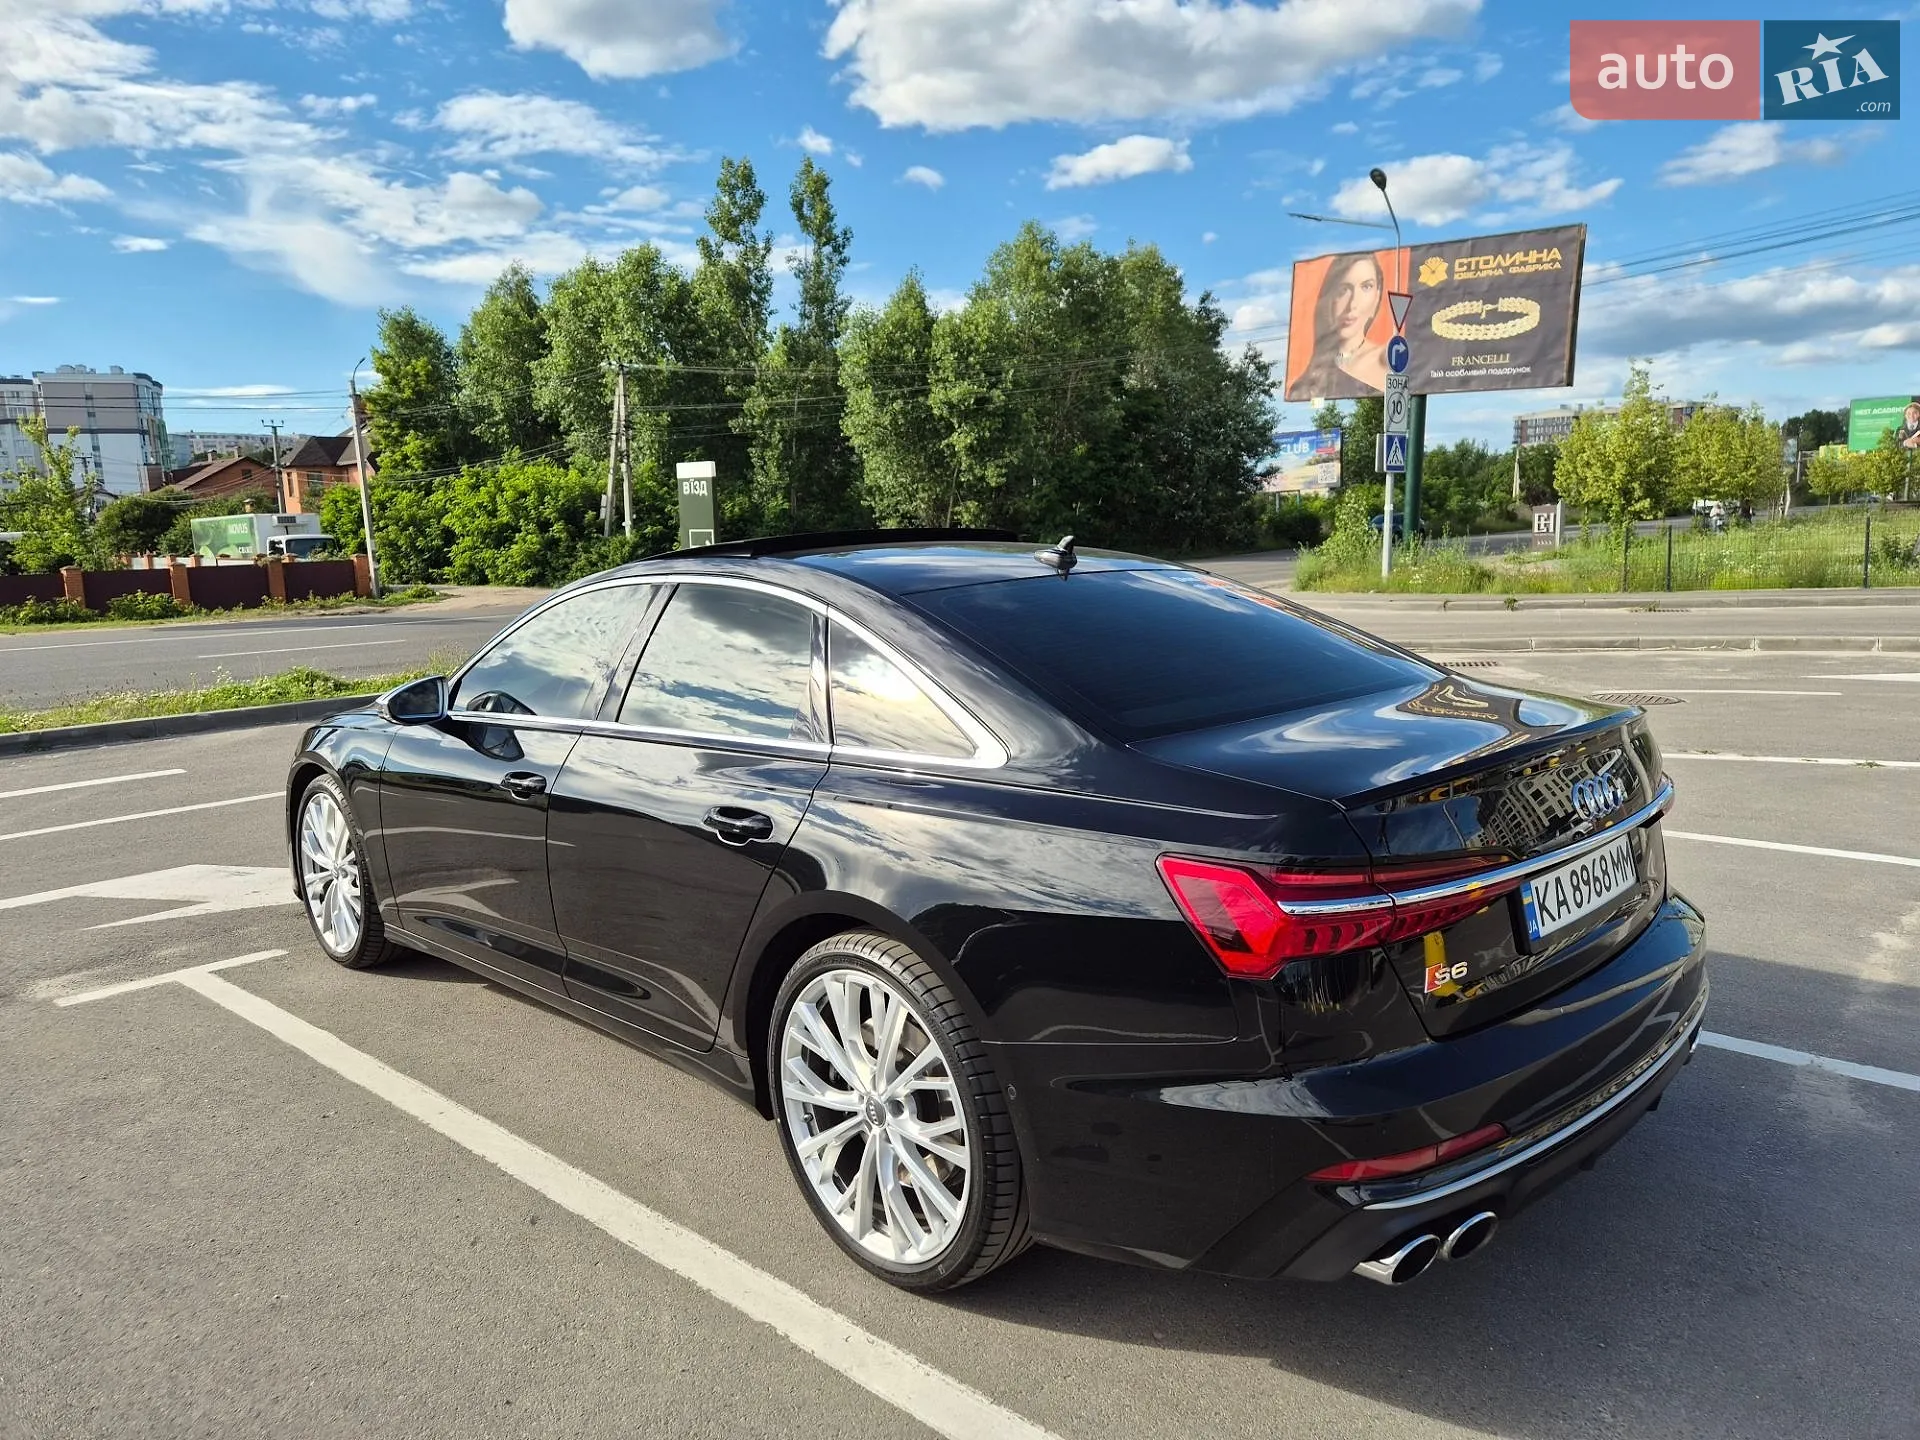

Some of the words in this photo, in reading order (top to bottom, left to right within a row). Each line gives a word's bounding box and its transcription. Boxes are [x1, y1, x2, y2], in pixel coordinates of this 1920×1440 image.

[1454, 247, 1562, 273] СТОЛИЧНА
[1451, 353, 1510, 366] FRANCELLI
[1445, 367, 1487, 377] особливий
[1387, 377, 1409, 390] ЗОНА
[1392, 400, 1403, 415] 10
[1534, 876, 1571, 928] KA
[1570, 854, 1612, 909] 8968
[1609, 841, 1635, 888] MM
[1434, 961, 1468, 985] S6
